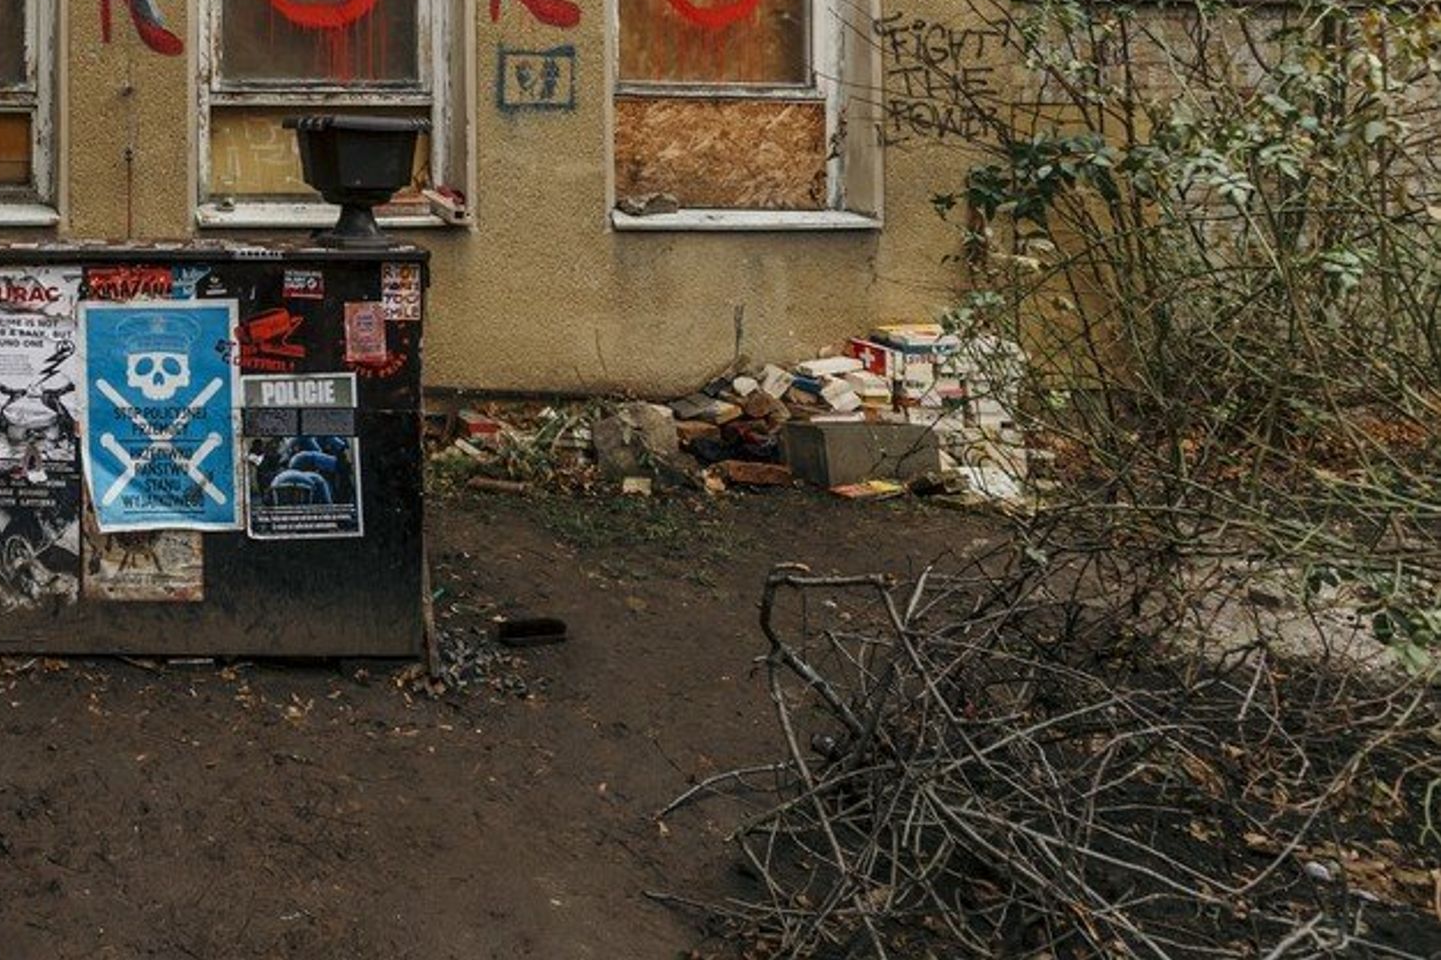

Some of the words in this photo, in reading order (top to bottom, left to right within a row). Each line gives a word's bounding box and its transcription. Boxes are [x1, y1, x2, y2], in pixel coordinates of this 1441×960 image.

[52, 329, 73, 339] BUT
[23, 338, 44, 348] ONE
[261, 380, 336, 407] POLICIE
